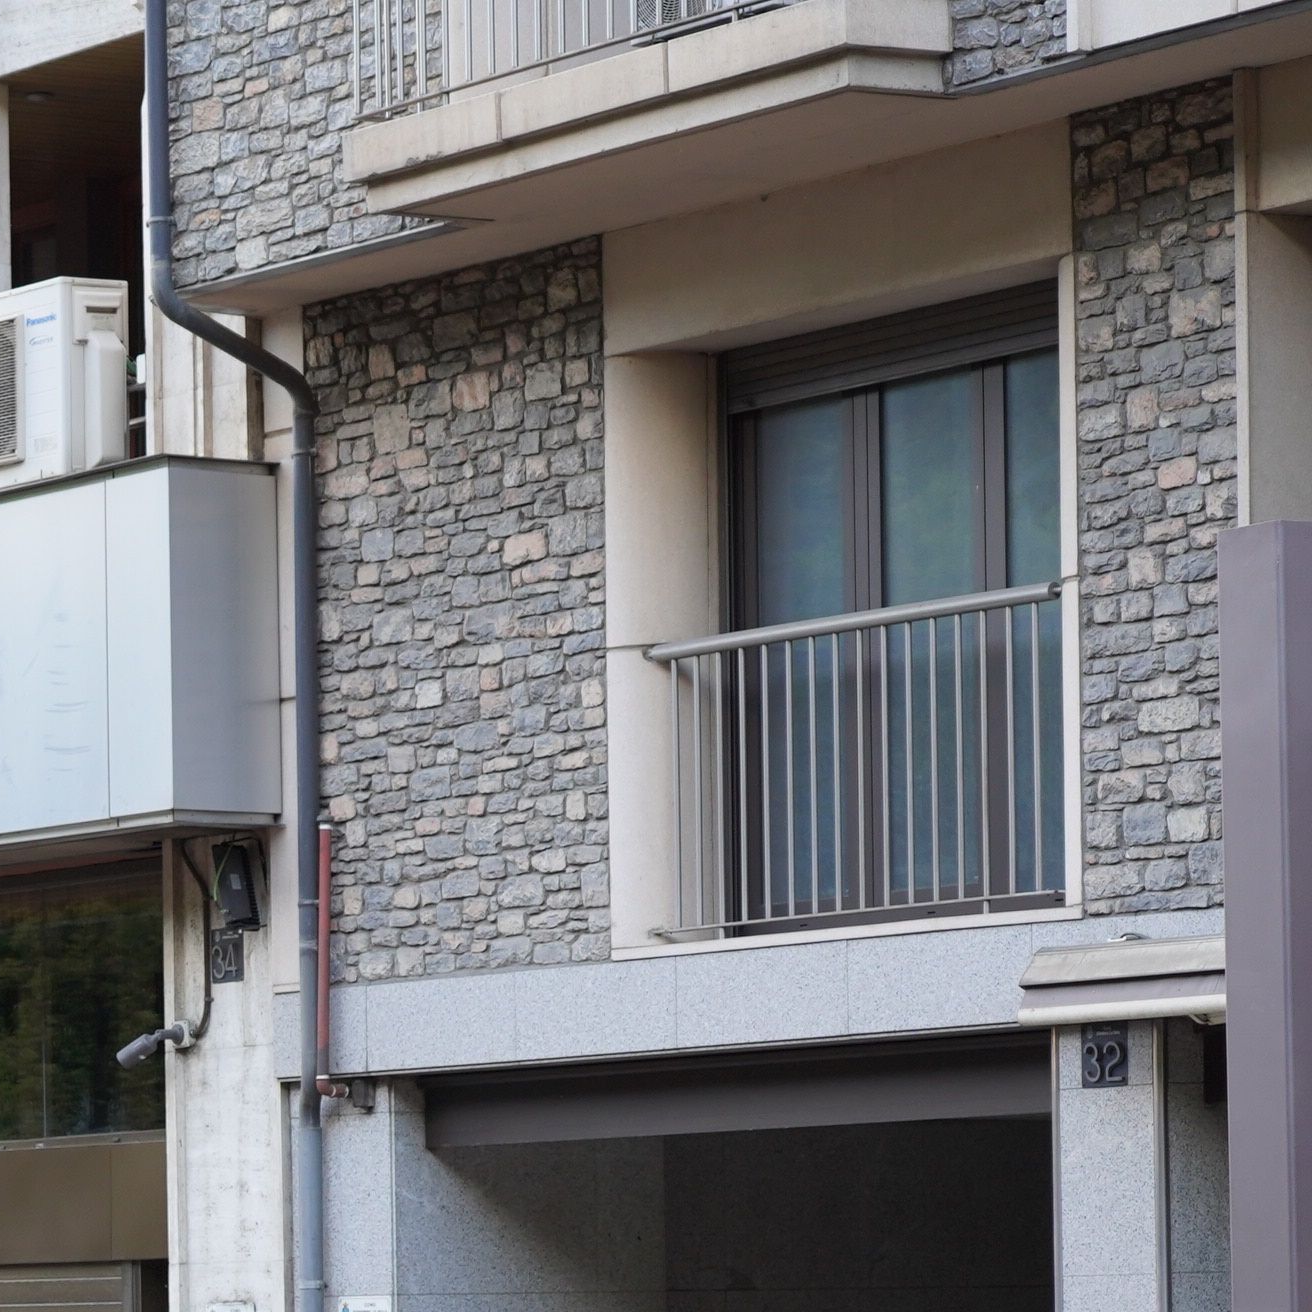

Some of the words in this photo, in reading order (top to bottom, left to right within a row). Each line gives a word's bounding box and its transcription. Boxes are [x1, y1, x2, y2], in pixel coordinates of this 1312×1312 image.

[26, 313, 57, 328] Panasonic
[212, 944, 237, 979] 34
[1084, 1041, 1123, 1083] 32
